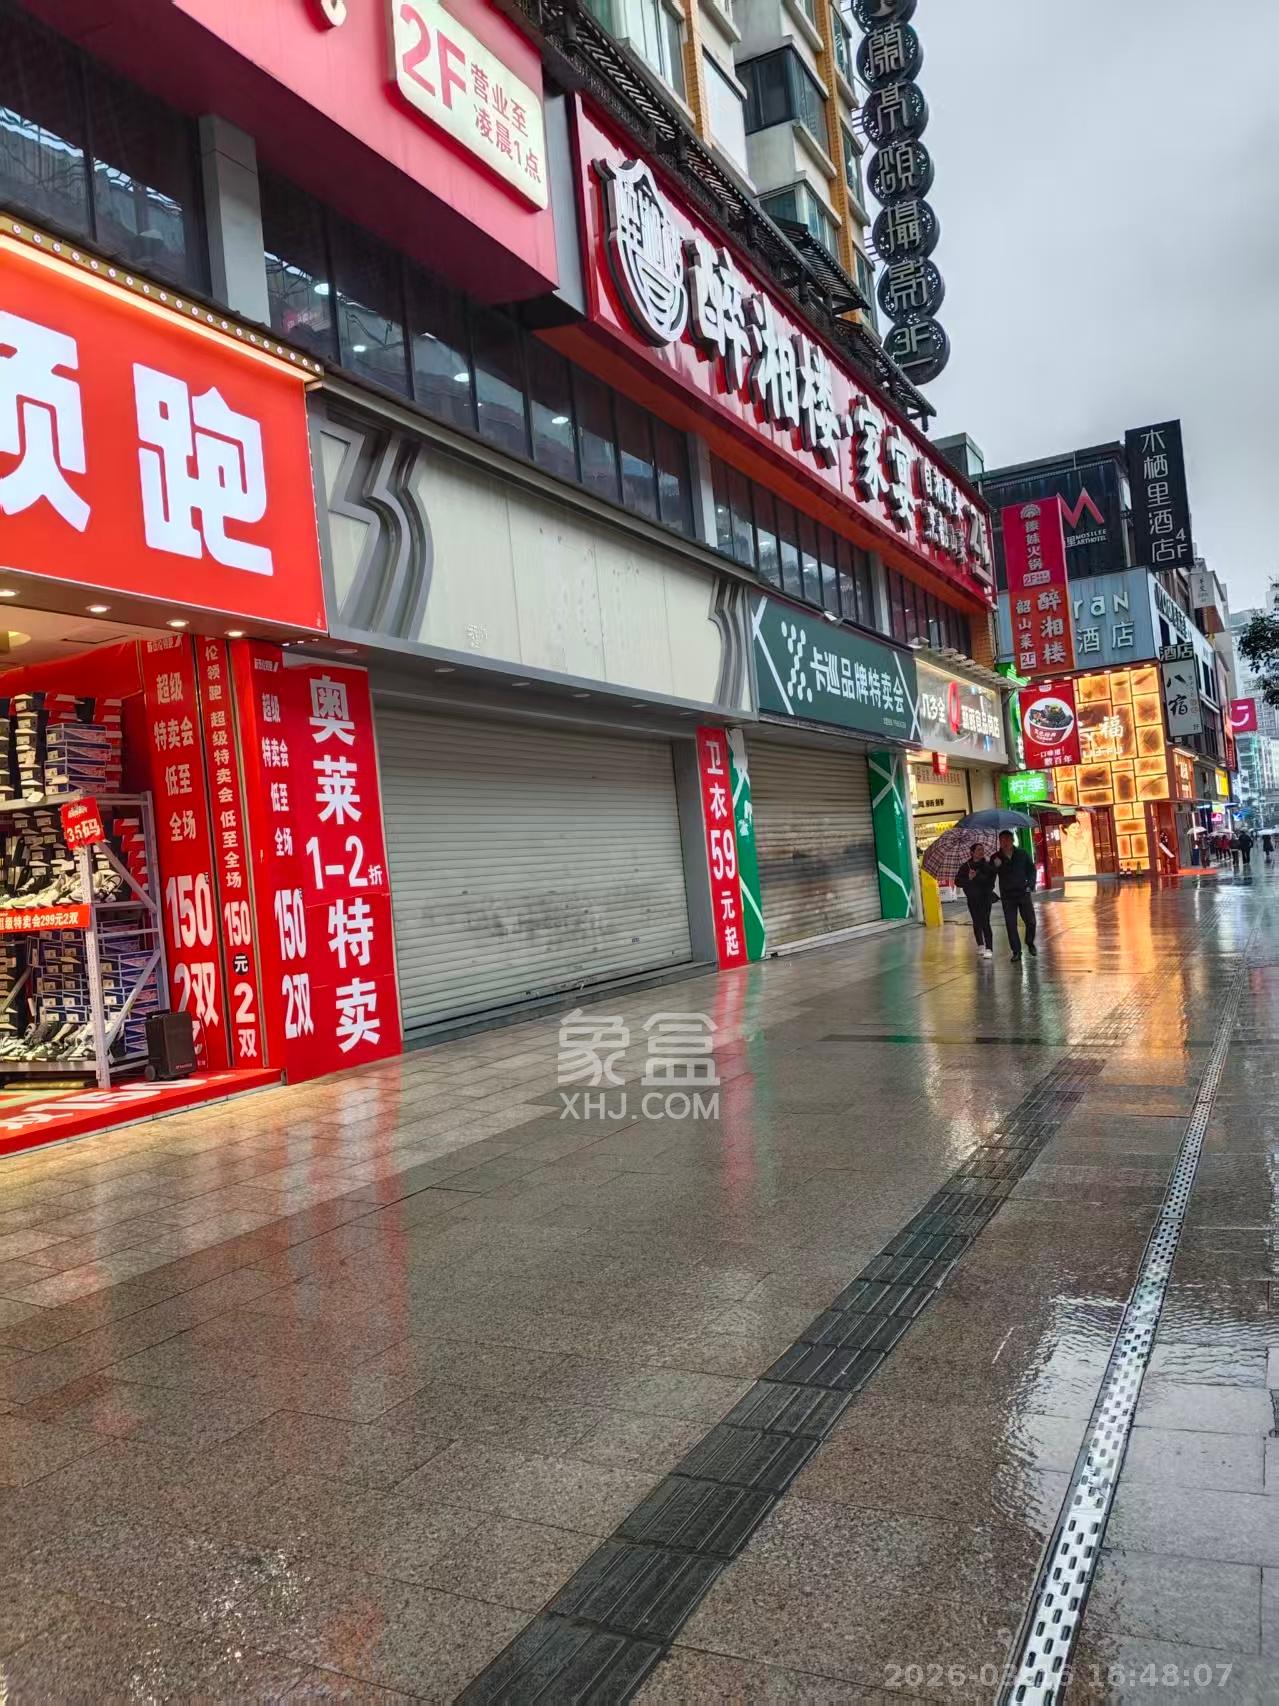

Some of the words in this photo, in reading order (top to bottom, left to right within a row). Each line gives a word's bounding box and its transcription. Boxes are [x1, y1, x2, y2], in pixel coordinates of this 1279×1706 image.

[400, 3, 466, 110] 2F
[471, 63, 528, 137] 营业至
[474, 103, 541, 183] 凌晨1点
[895, 321, 930, 356] 3F
[1140, 429, 1175, 563] 木栖里酒店
[1037, 588, 1067, 665] 醉湘楼
[1077, 621, 1135, 653] 酒店
[1021, 653, 1035, 663] 2F
[1160, 643, 1193, 661] 酒店
[156, 671, 184, 704] 超级
[262, 692, 281, 723] 超级
[154, 715, 194, 751] 特卖会
[210, 710, 234, 803] 超级特卖会
[261, 736, 289, 767] 特卖会
[165, 763, 192, 796] 低至
[271, 782, 290, 812] 低至
[67, 818, 101, 843] 35码
[169, 810, 196, 841] 全场
[274, 827, 293, 856] 全场
[219, 810, 242, 888] 低至全场
[166, 872, 213, 949] 150
[224, 900, 251, 947] 150
[274, 888, 306, 961] 150
[234, 955, 248, 973] 元
[174, 961, 219, 1027] 2双
[233, 982, 256, 1024] 2
[282, 973, 314, 1040] 2双
[238, 1028, 258, 1058] 双
